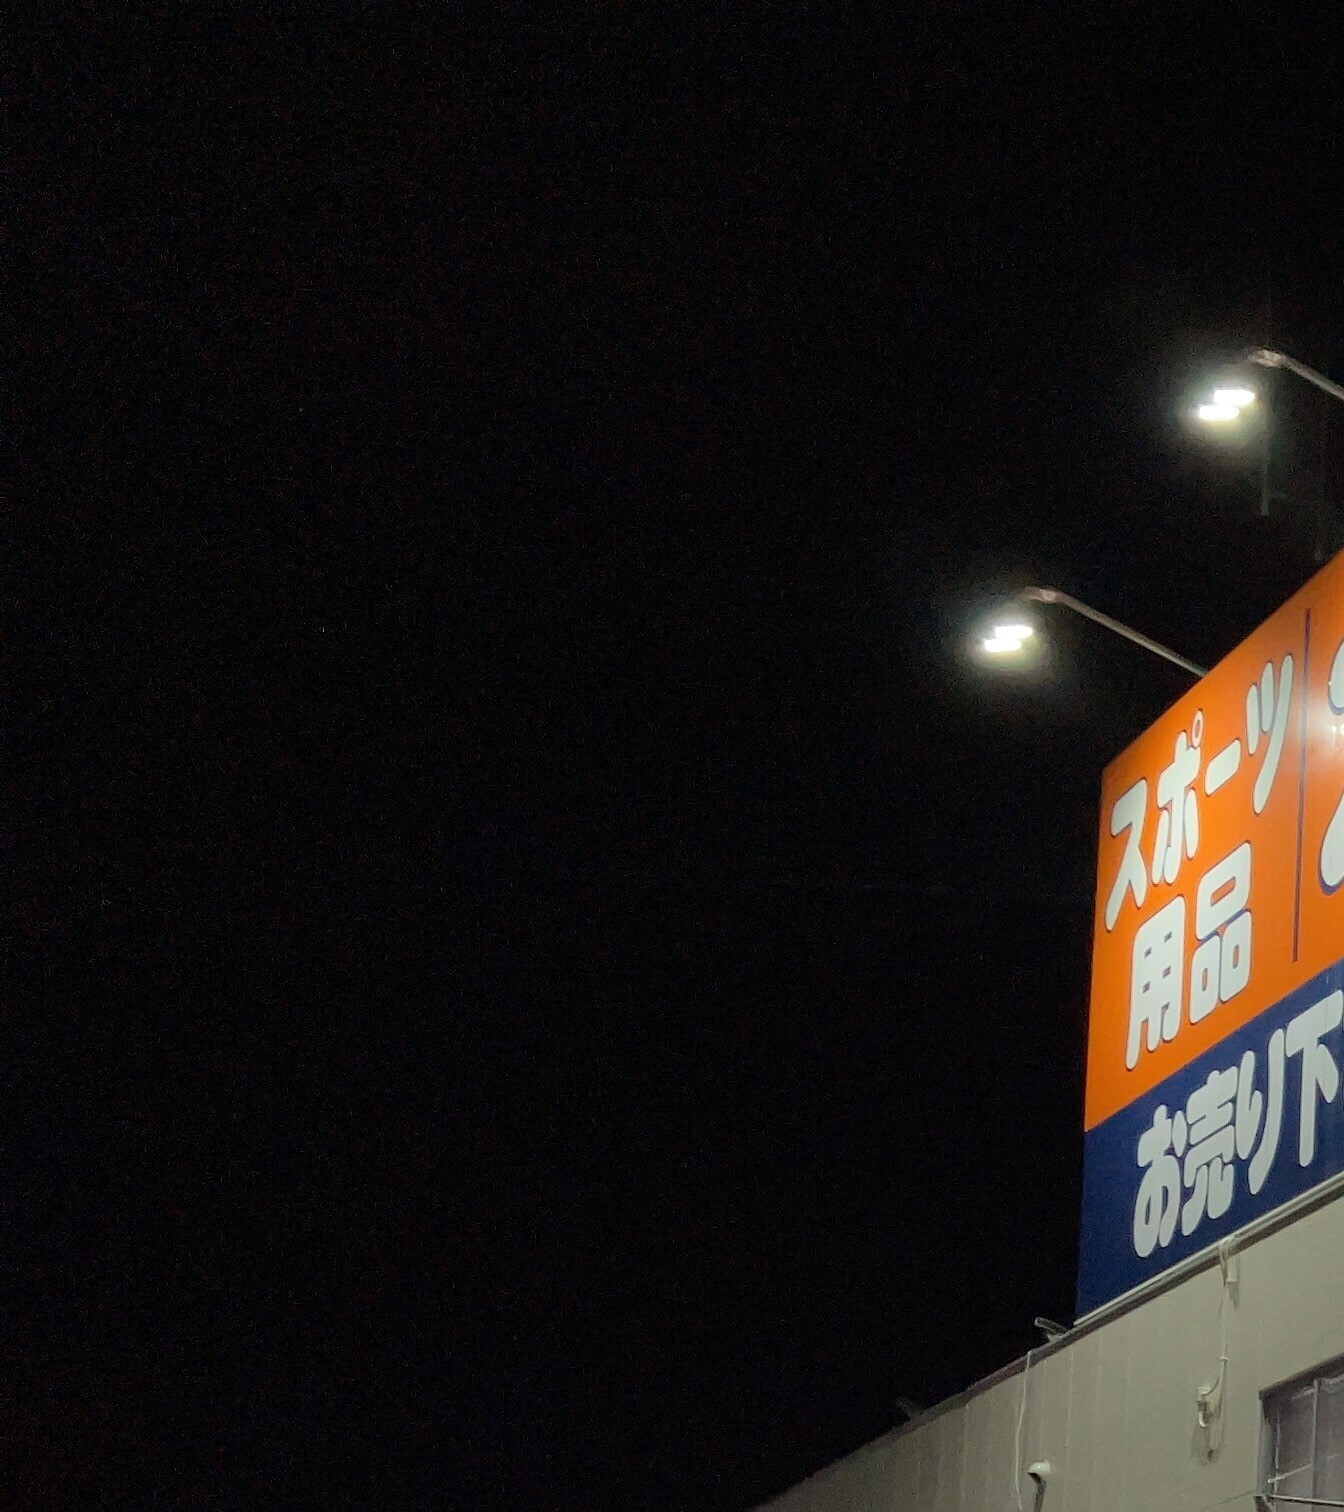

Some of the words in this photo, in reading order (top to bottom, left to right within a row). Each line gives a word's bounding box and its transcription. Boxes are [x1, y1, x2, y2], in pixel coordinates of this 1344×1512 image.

[1105, 652, 1295, 932] スポーツ
[1124, 842, 1253, 1072] 用品
